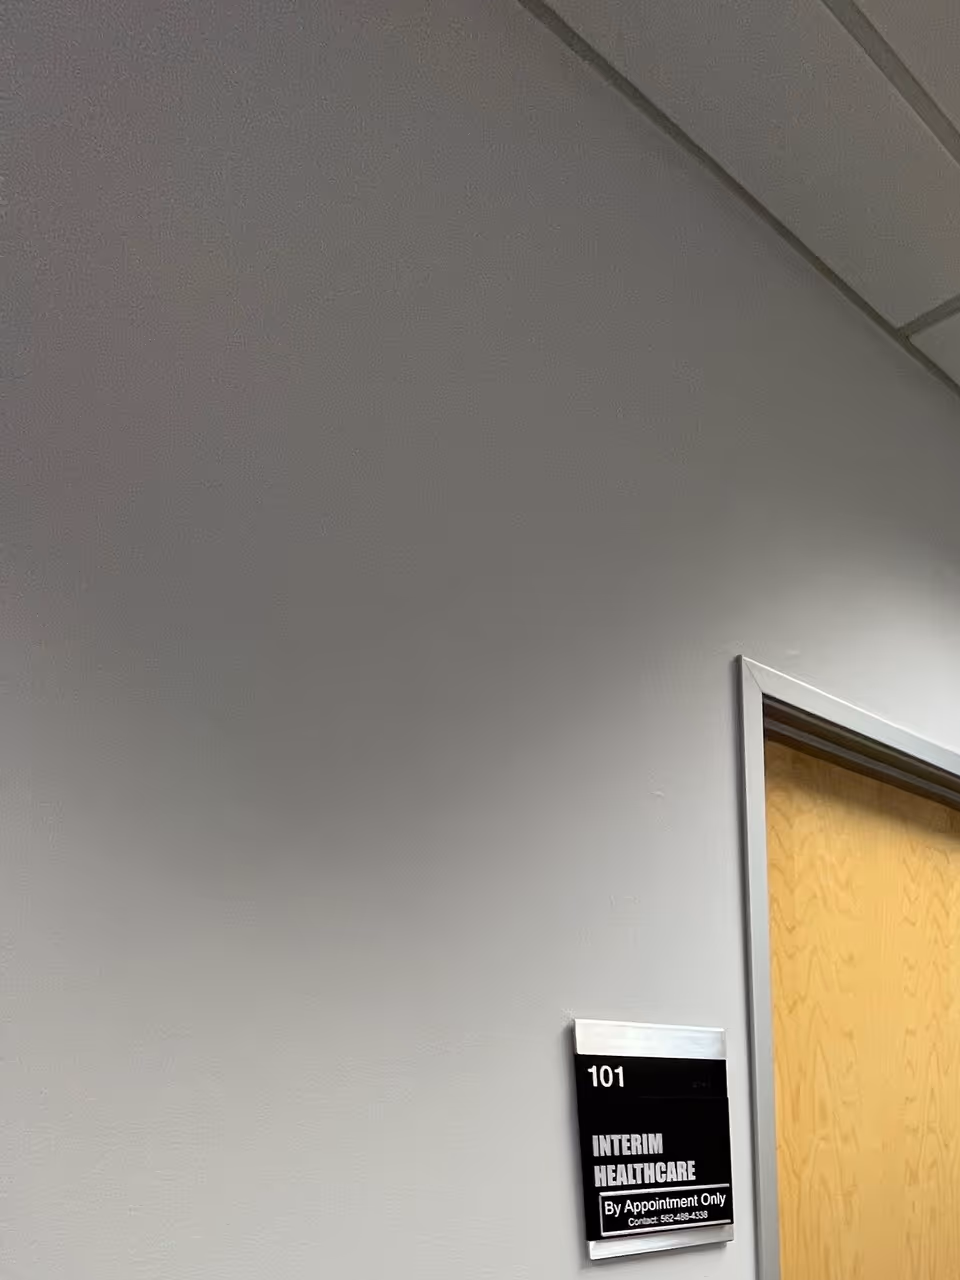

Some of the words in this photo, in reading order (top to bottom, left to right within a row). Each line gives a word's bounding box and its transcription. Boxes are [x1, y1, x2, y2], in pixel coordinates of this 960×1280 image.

[587, 1065, 624, 1087] 101
[592, 1133, 663, 1157] INTERIM
[594, 1160, 696, 1187] HEALTHCARE
[604, 1201, 621, 1217] By
[624, 1195, 698, 1215] Appointment
[701, 1192, 726, 1207] Only
[628, 1216, 659, 1226] Contact:
